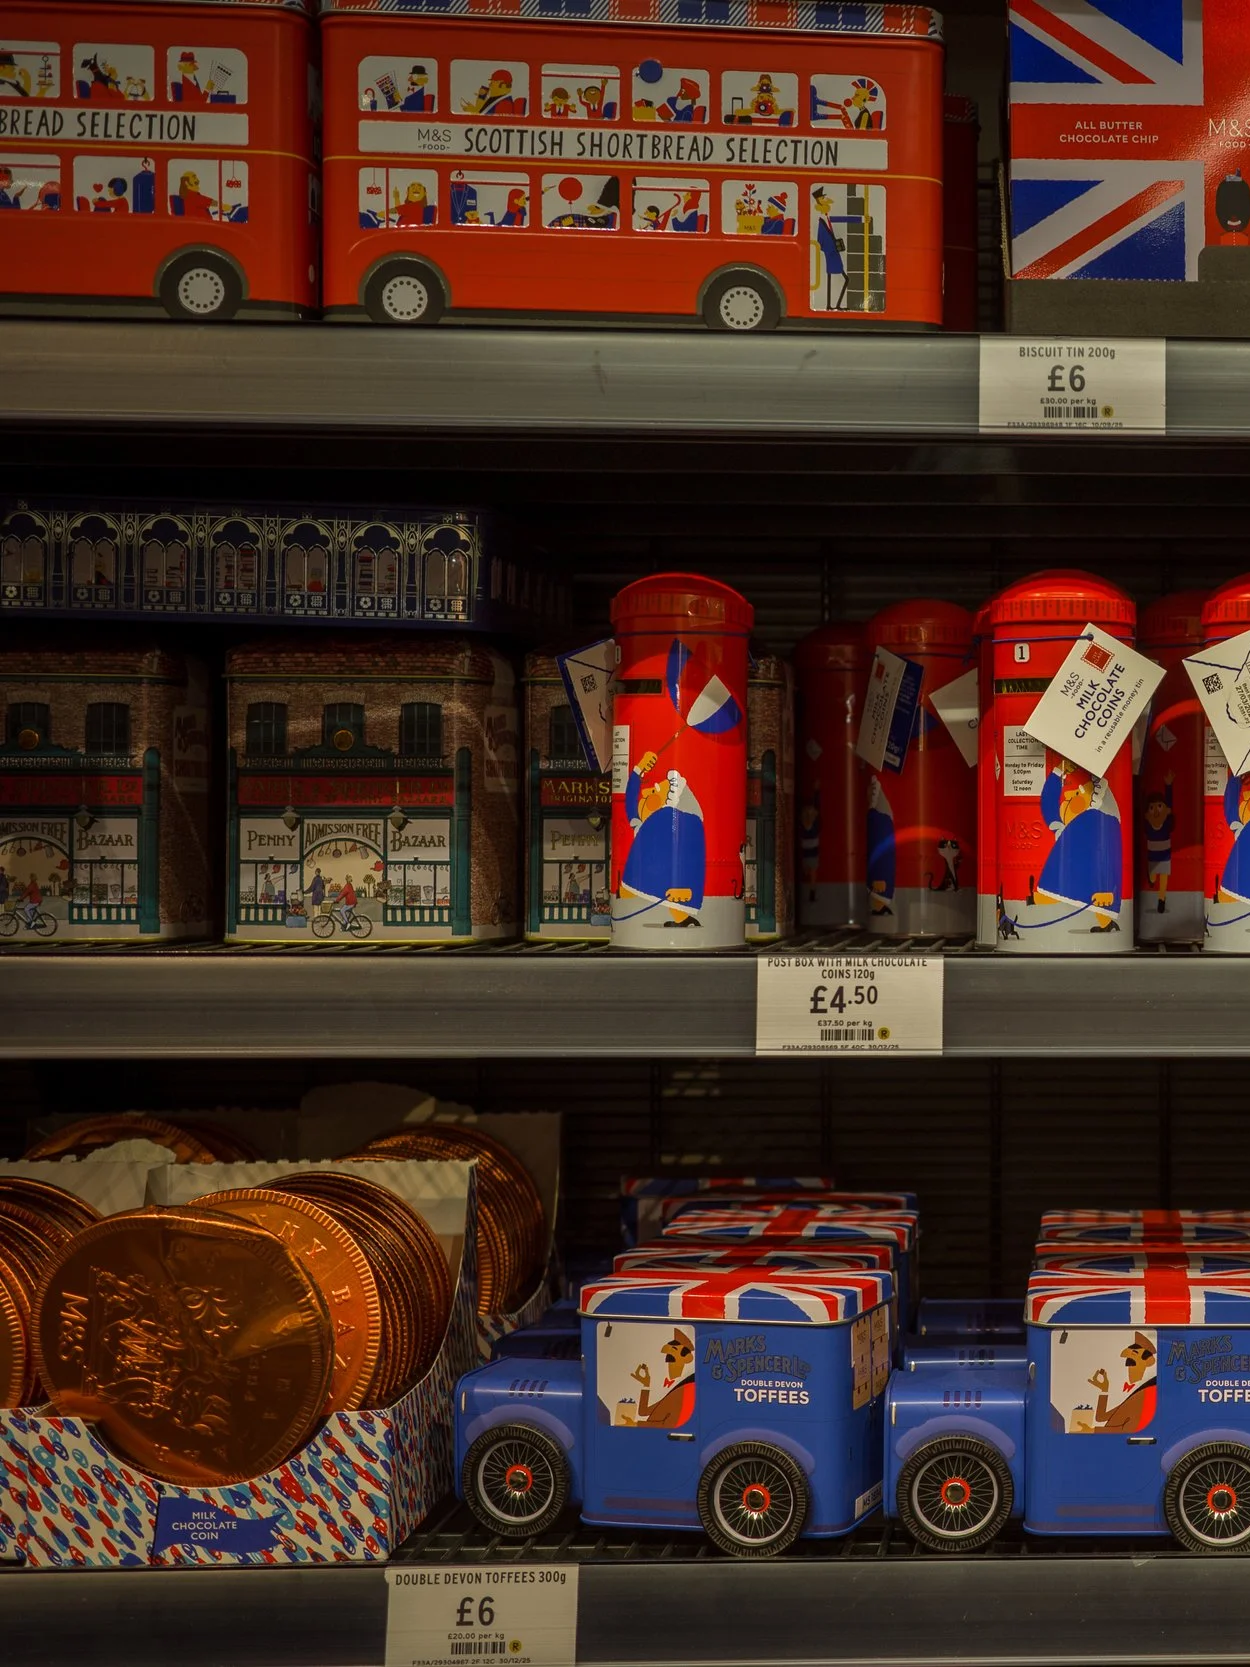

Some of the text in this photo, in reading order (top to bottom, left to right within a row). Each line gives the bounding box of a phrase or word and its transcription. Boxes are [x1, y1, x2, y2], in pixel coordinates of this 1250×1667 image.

[77, 112, 196, 141] SELECTION
[418, 129, 451, 142] M&S
[1075, 121, 1143, 130] ALL BUTTER
[464, 127, 839, 165] SCOTTISH SHORTBREAD SELECTION
[1059, 134, 1159, 143] CHOCOLATE CHIP
[1019, 346, 1116, 359] BISCUIT TIN 200g
[1047, 364, 1086, 392] £6
[1060, 672, 1080, 696] M&S
[1074, 663, 1125, 738] CHOCOLATE
[1076, 679, 1100, 710] MILK
[1097, 688, 1125, 727] COINS
[1104, 689, 1139, 740] reusable money
[543, 779, 611, 796] MARKS
[41, 821, 67, 840] FREE
[76, 829, 135, 850] BAZAAR
[247, 830, 296, 850] PENNY
[305, 823, 381, 848] ADMISSION FREE
[390, 830, 446, 851] BAZAAR
[767, 957, 928, 967] POST BOX WITH CHOCOLATE
[821, 969, 875, 980] COINS 120g
[809, 985, 878, 1013] £4.50
[703, 1335, 766, 1364] MARKS
[1166, 1335, 1233, 1366] MARKS
[724, 1355, 791, 1383] SPENCER
[741, 1379, 803, 1388] DOUBLE DEVON
[1205, 1379, 1239, 1387] DOUBLE
[733, 1388, 810, 1405] TOFFEES
[171, 1521, 237, 1530] CHOCOLATE
[192, 1511, 216, 1520] MILK
[190, 1532, 219, 1540] COIN
[395, 1570, 566, 1586] DOUBLE DEVON TOFFEES 300g
[456, 1596, 495, 1626] £6
